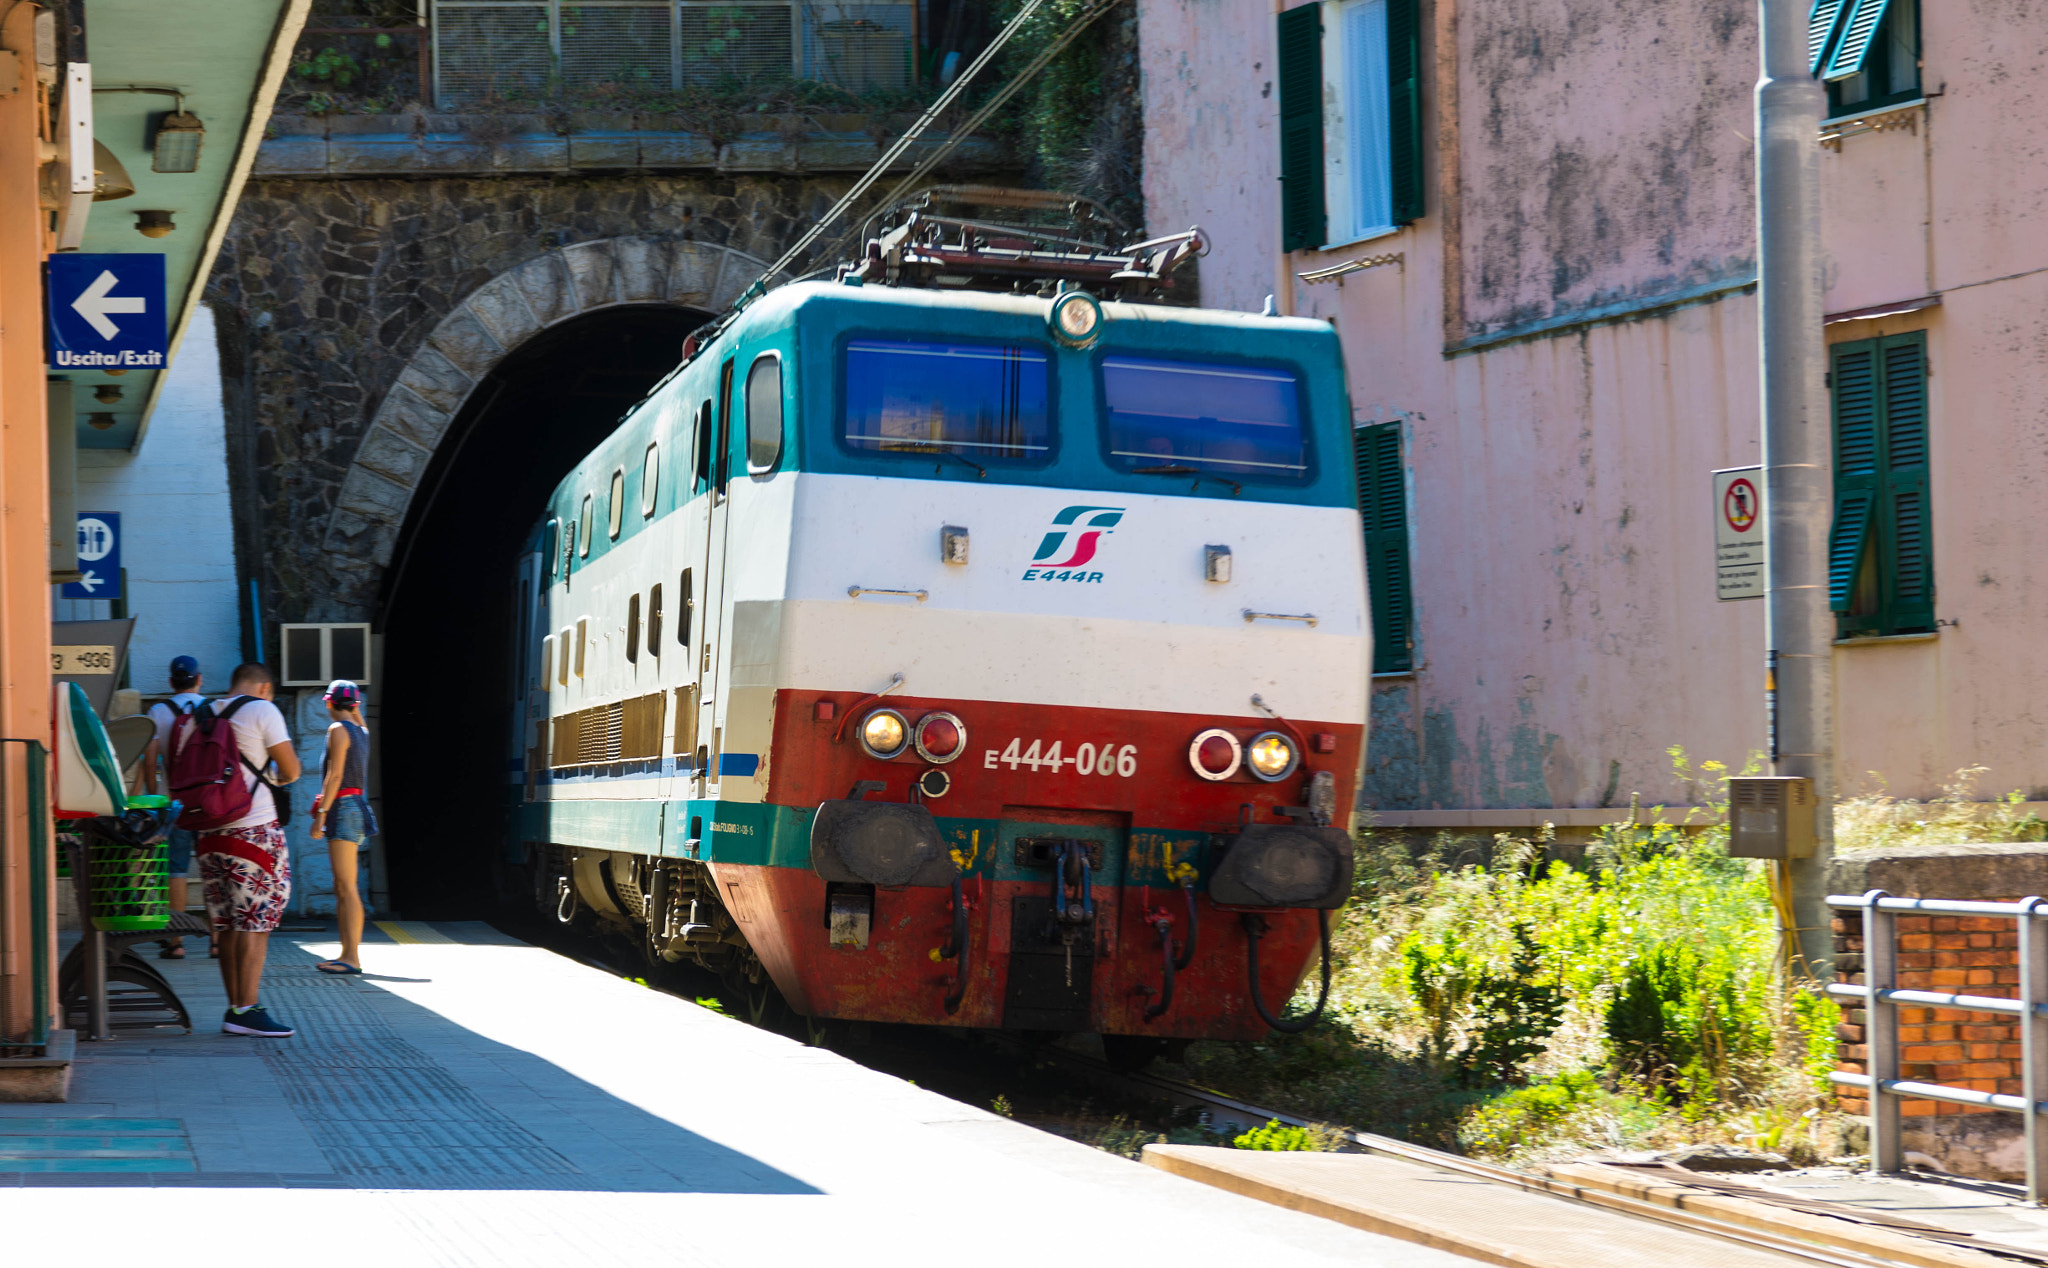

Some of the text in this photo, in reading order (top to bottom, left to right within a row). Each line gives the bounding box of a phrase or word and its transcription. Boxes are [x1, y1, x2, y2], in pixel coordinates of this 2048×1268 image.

[56, 350, 163, 366] Uscita/Exit
[1021, 569, 1105, 584] E444R
[76, 651, 111, 669] +936
[983, 737, 1138, 778] E444-066
